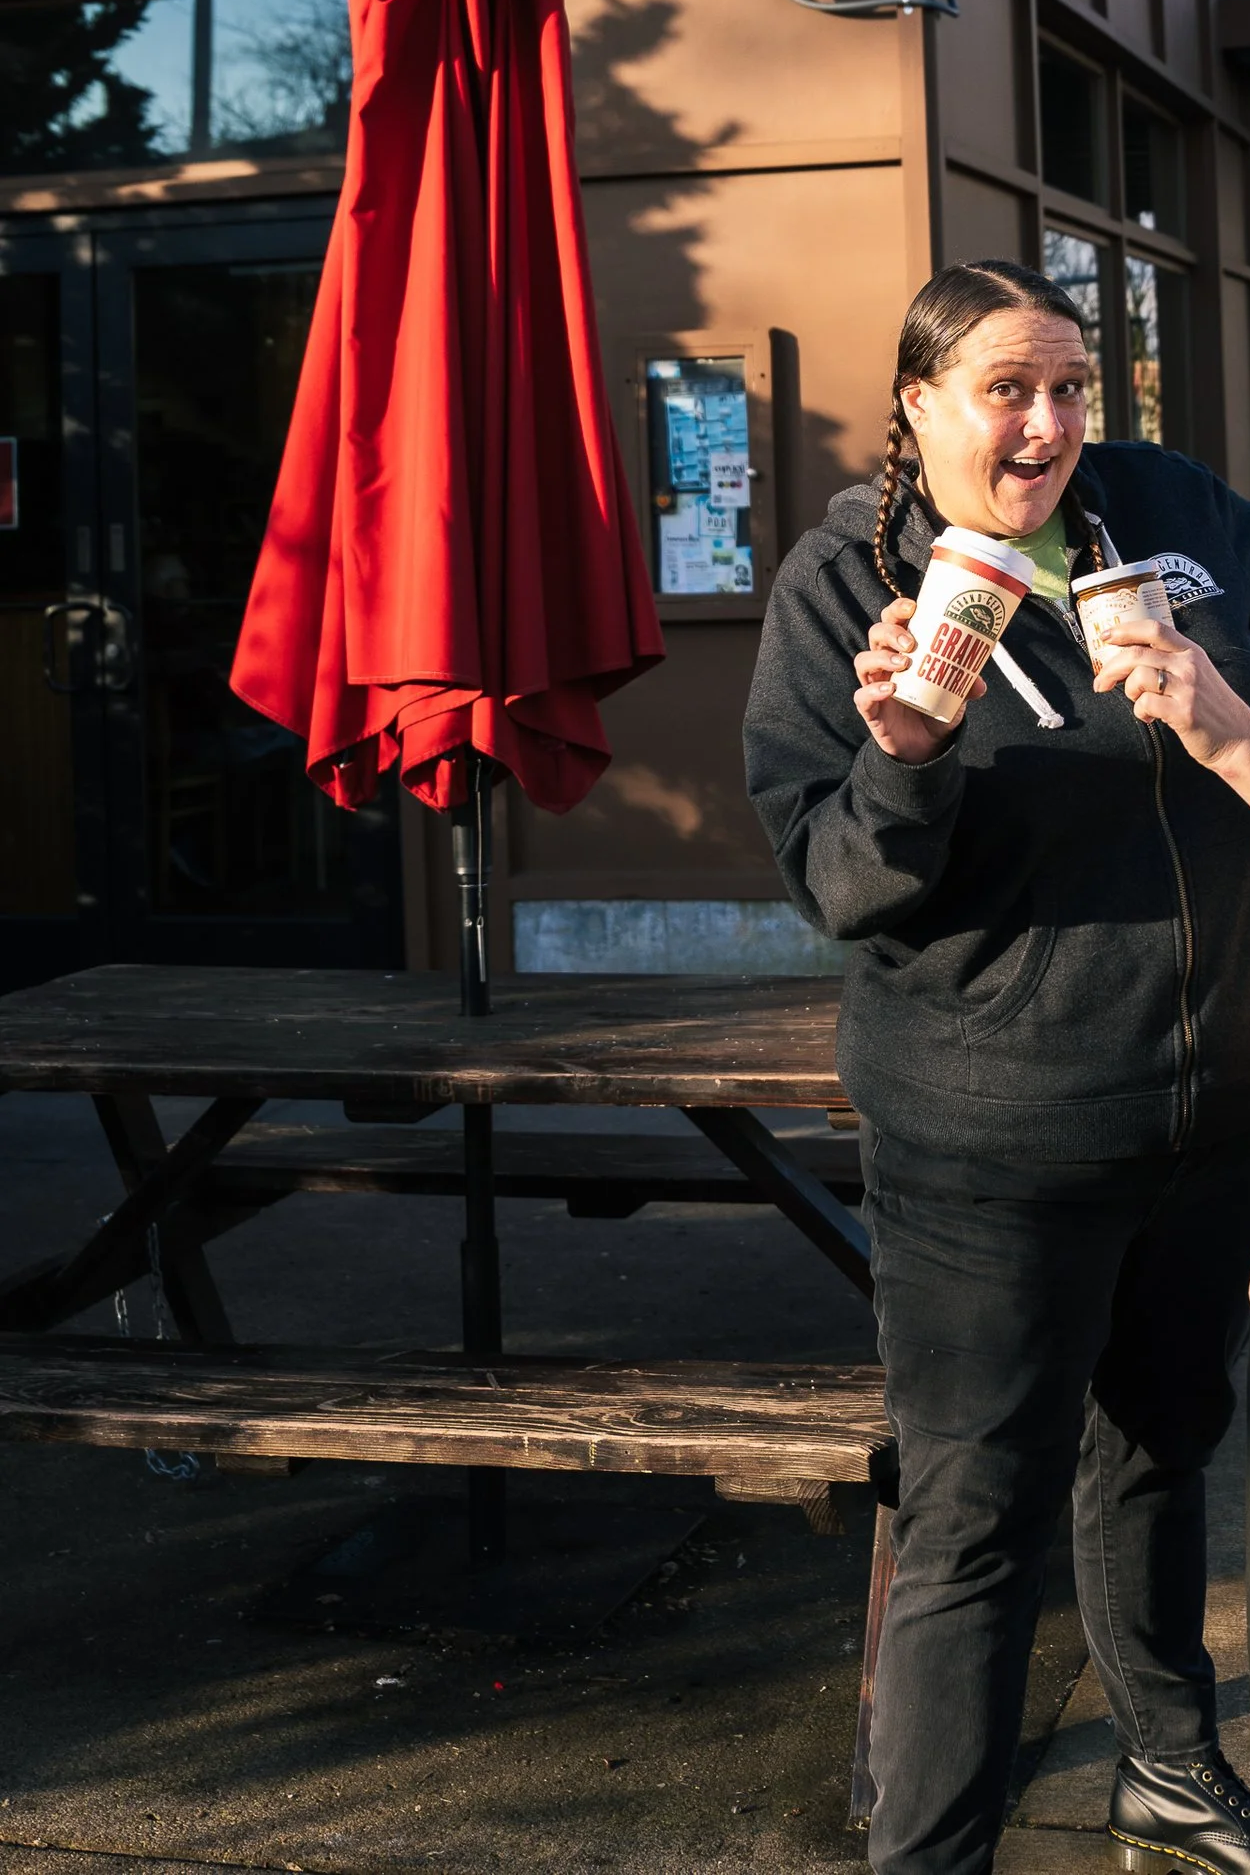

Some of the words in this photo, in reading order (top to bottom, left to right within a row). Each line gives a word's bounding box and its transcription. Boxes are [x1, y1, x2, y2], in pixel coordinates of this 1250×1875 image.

[1157, 557, 1210, 585] CENTRAL
[951, 593, 982, 612] GRAND
[929, 622, 991, 674] GRAND
[917, 653, 974, 699] CENTRAL
